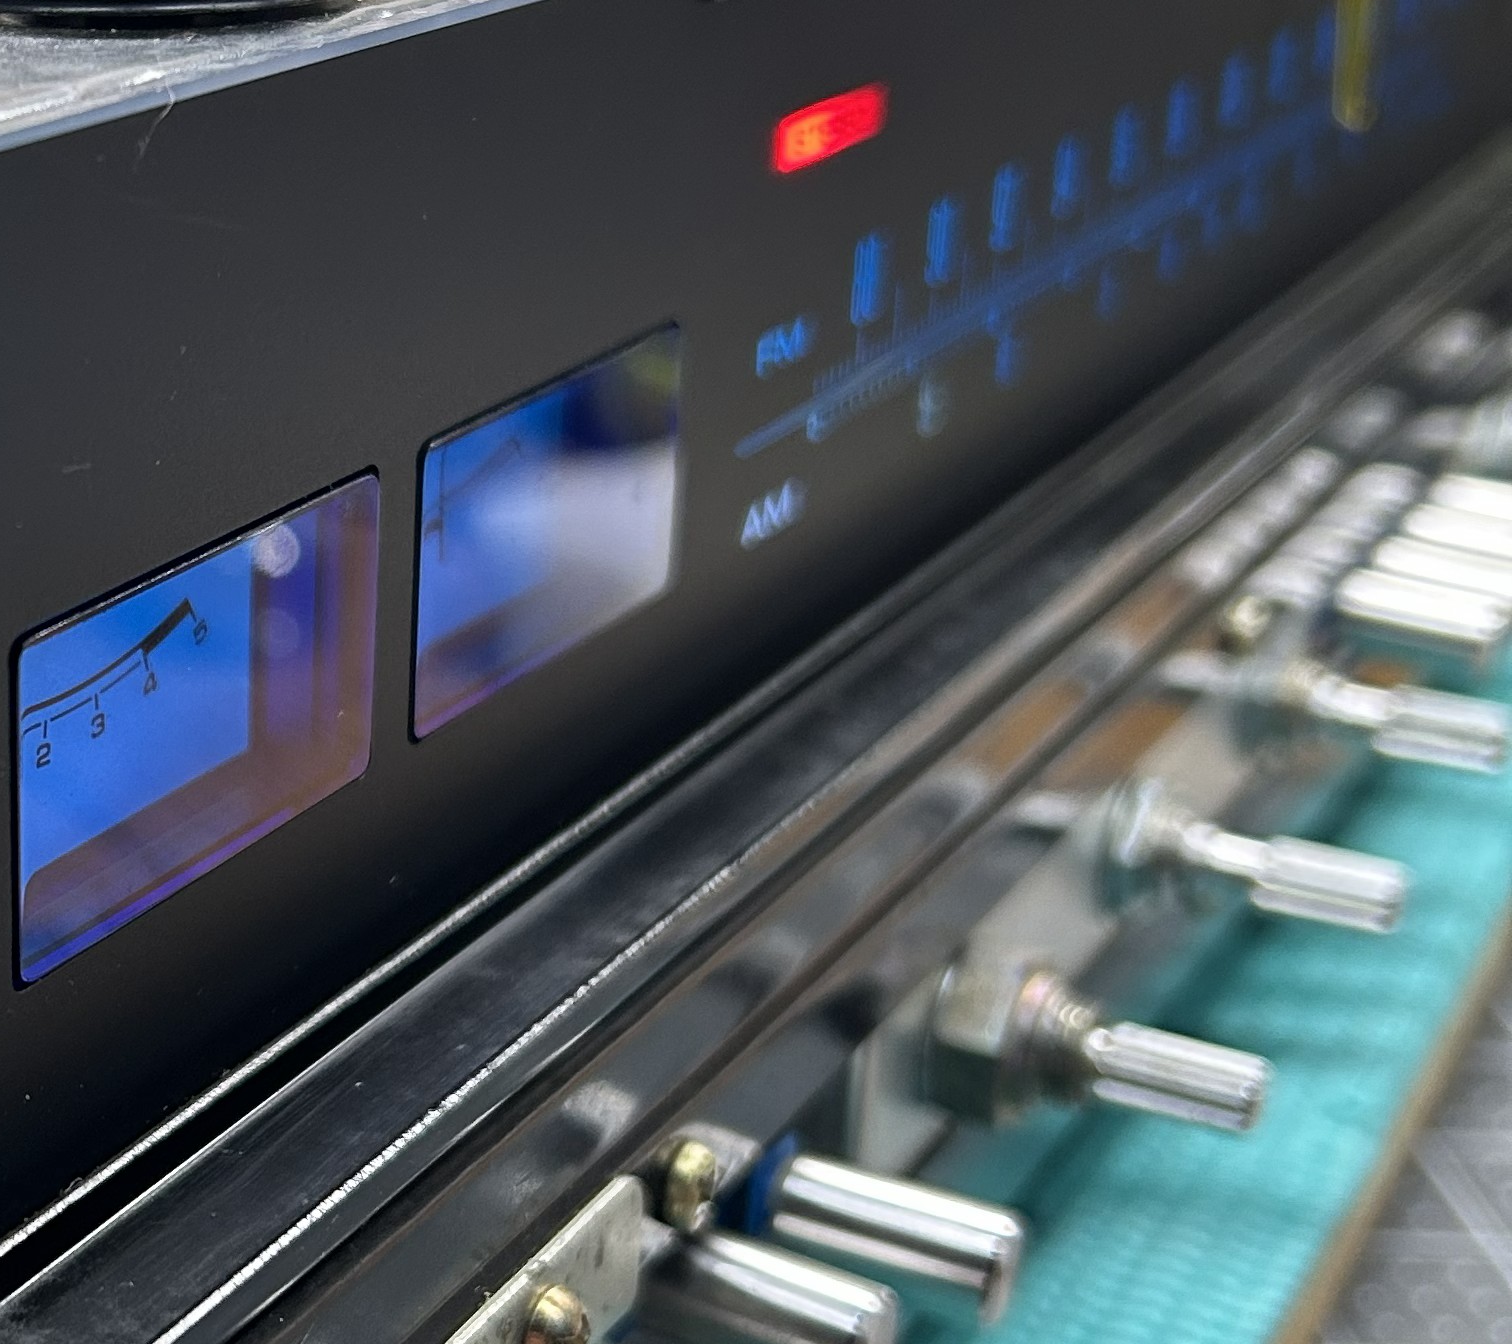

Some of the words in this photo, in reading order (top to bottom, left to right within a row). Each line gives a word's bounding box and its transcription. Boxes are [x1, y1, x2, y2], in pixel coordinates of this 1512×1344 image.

[755, 313, 816, 379] FM
[740, 476, 806, 550] AM
[36, 742, 51, 769] 2
[90, 712, 105, 739] 3
[143, 671, 157, 696] 4
[193, 618, 207, 645] 5
